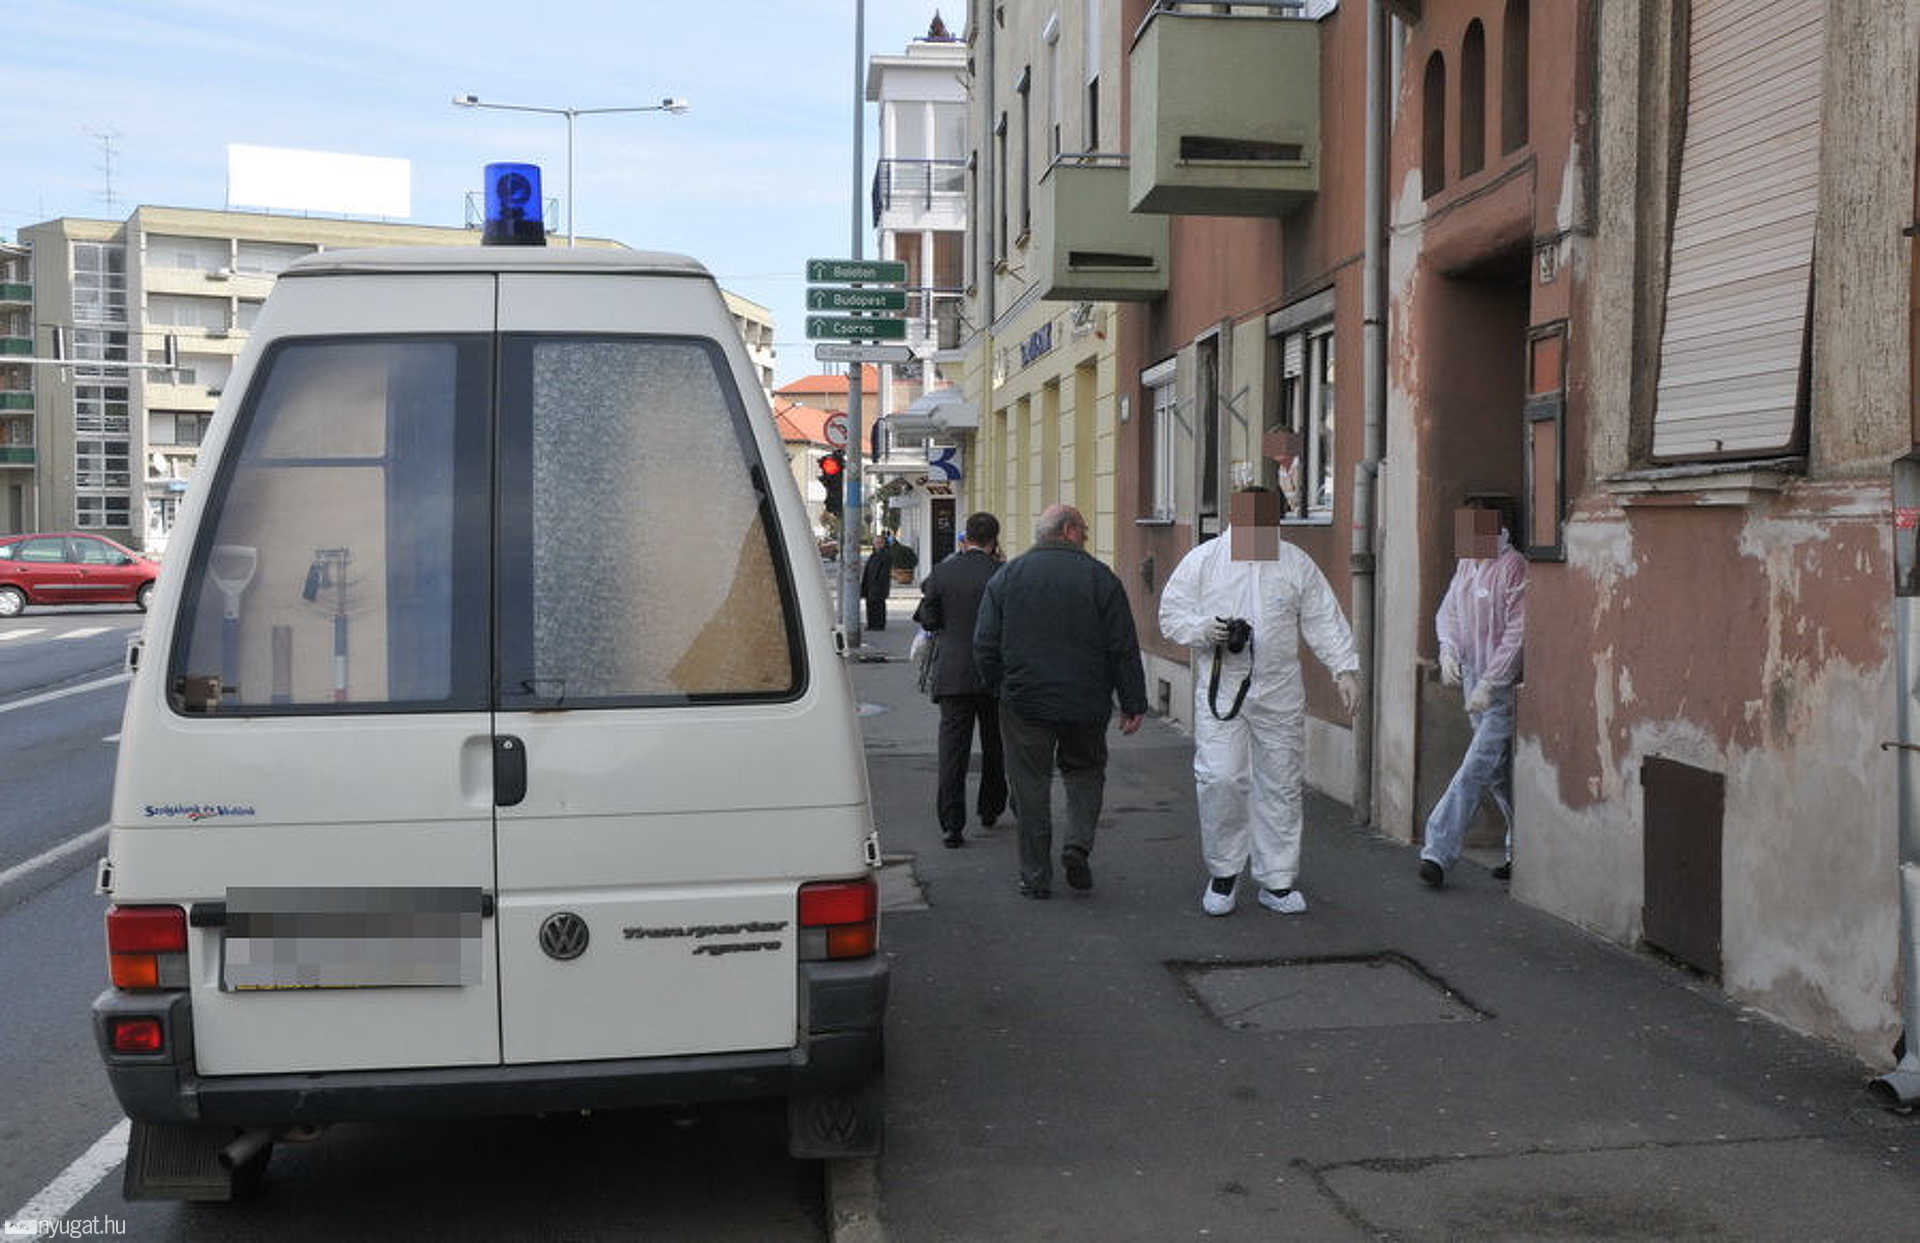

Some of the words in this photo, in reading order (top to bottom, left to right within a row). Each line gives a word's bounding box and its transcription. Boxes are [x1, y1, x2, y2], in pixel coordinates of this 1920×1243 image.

[833, 294, 886, 307] Budapest
[833, 322, 874, 334] Csorna
[623, 920, 789, 939] Transporter
